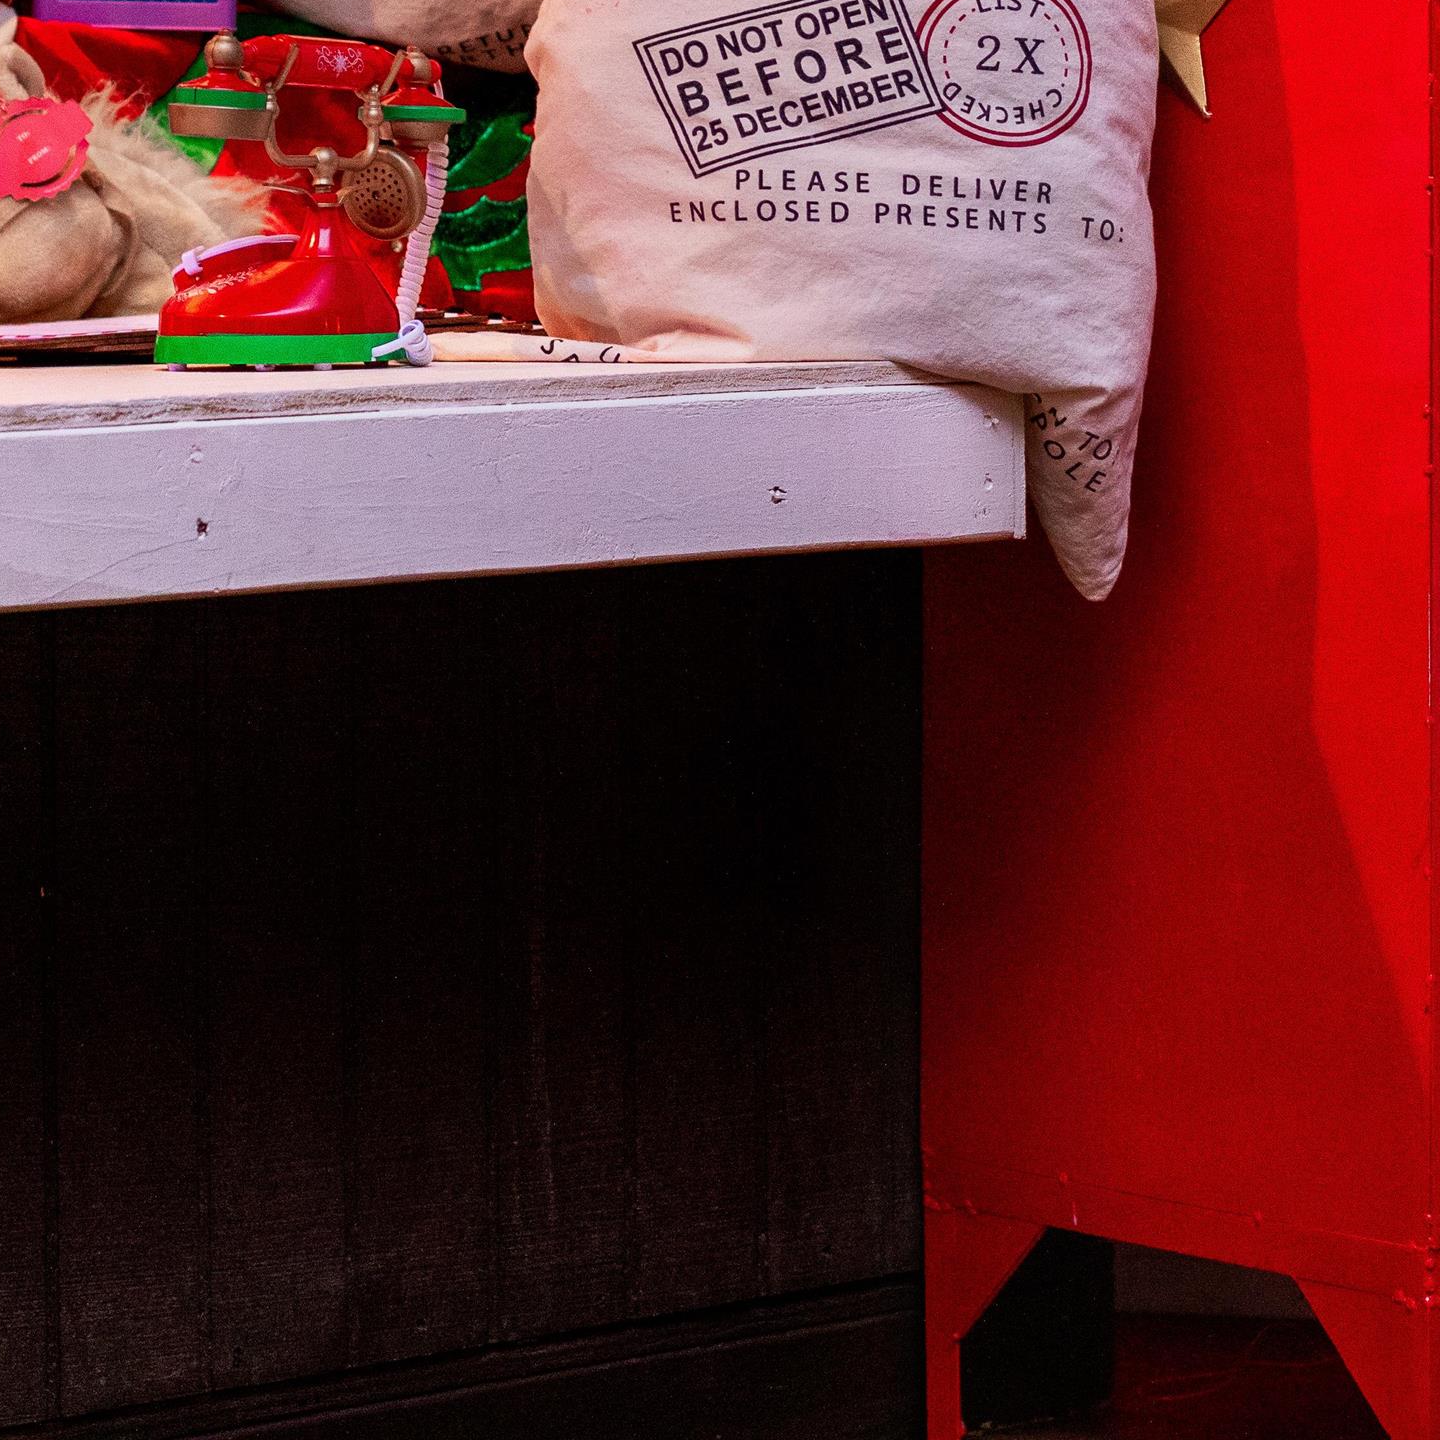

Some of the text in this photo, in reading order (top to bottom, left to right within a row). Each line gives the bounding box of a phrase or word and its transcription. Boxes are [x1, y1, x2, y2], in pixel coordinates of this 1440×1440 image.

[659, 39, 709, 77] DO
[716, 20, 784, 61] NOT
[676, 26, 910, 117] BEFORE
[691, 68, 921, 153] 25 DECEMBER
[943, 81, 1063, 125] CHECKED
[735, 168, 1053, 204] PLEASE DELIVER
[670, 200, 1127, 244] ENCLOSED PRESENTS TO:
[1031, 413, 1107, 493] POLE
